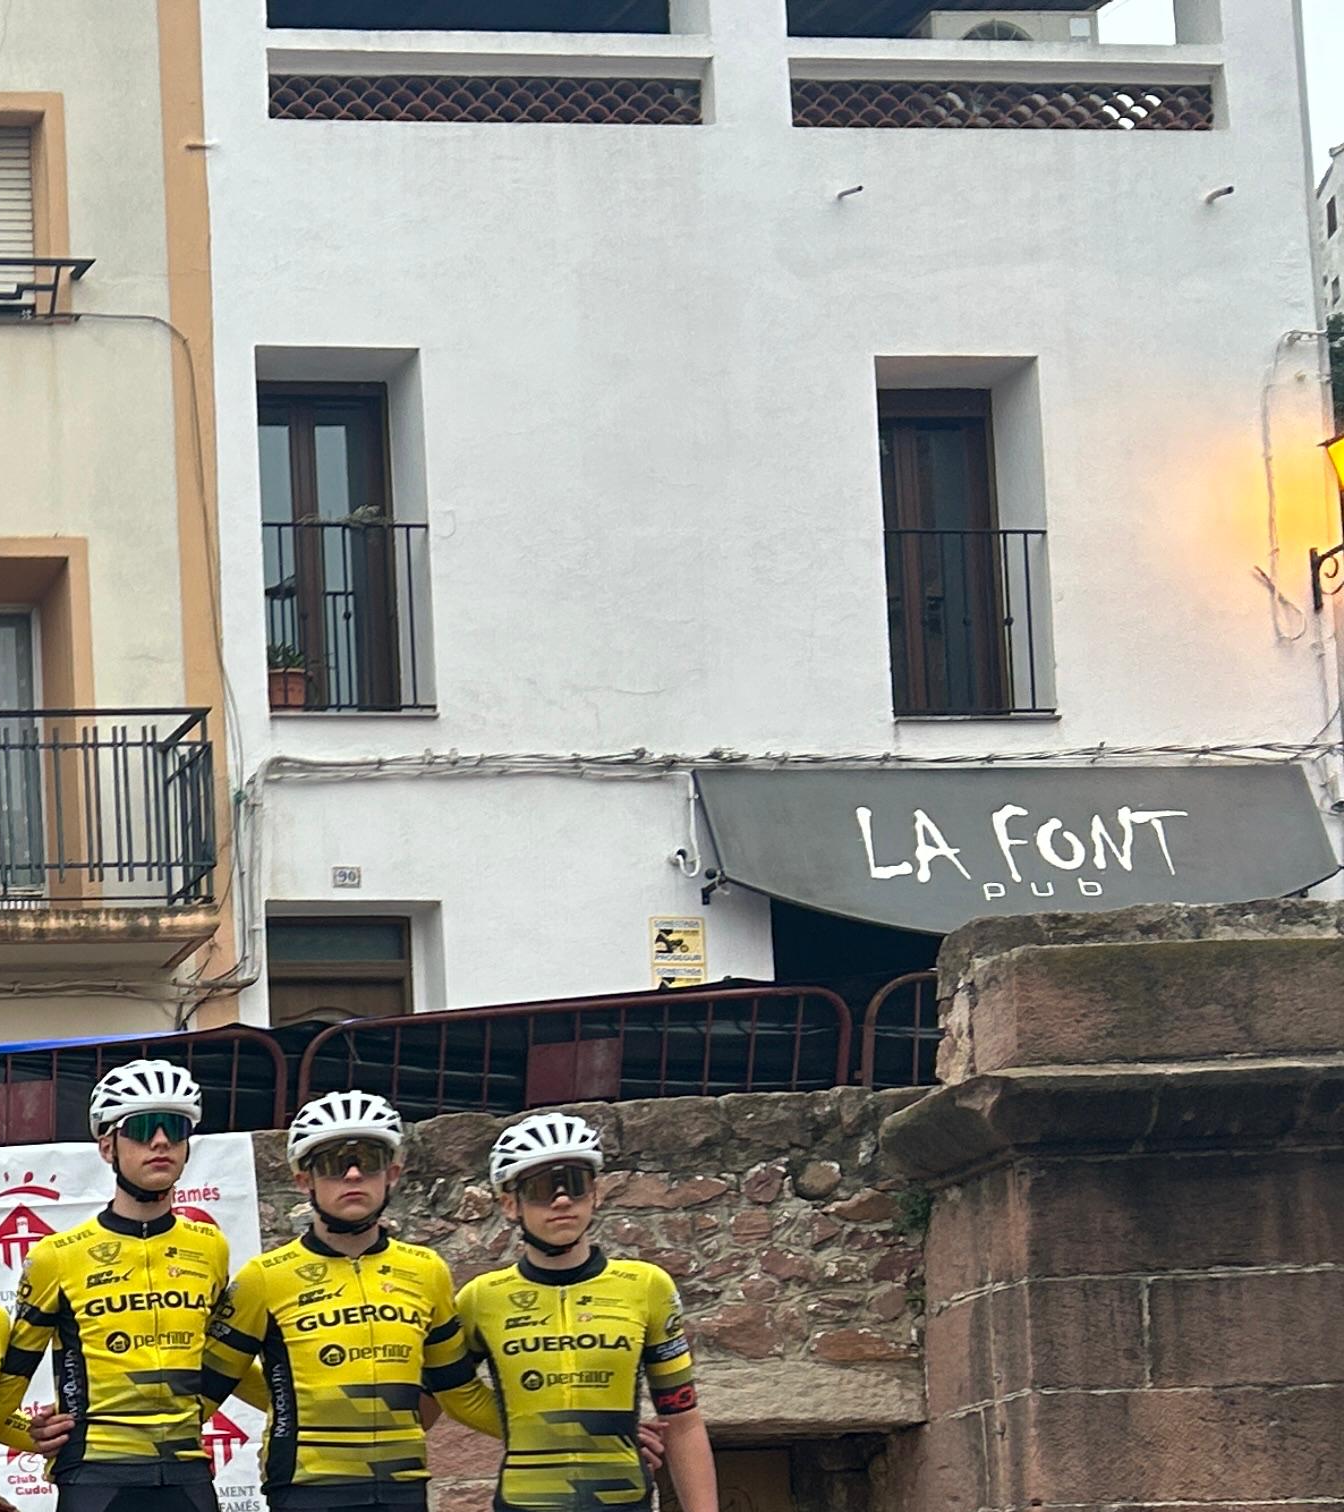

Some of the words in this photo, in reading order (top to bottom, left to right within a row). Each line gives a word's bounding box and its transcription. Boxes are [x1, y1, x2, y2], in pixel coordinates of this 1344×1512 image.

[856, 806, 971, 882] LA
[992, 804, 1188, 882] FONT
[338, 870, 357, 882] 90
[983, 878, 1103, 900] pub
[85, 1291, 207, 1317] GUEROLA
[296, 1304, 422, 1332] GUEROLA
[503, 1334, 632, 1355] GUEROLA
[8, 1475, 37, 1484] Club
